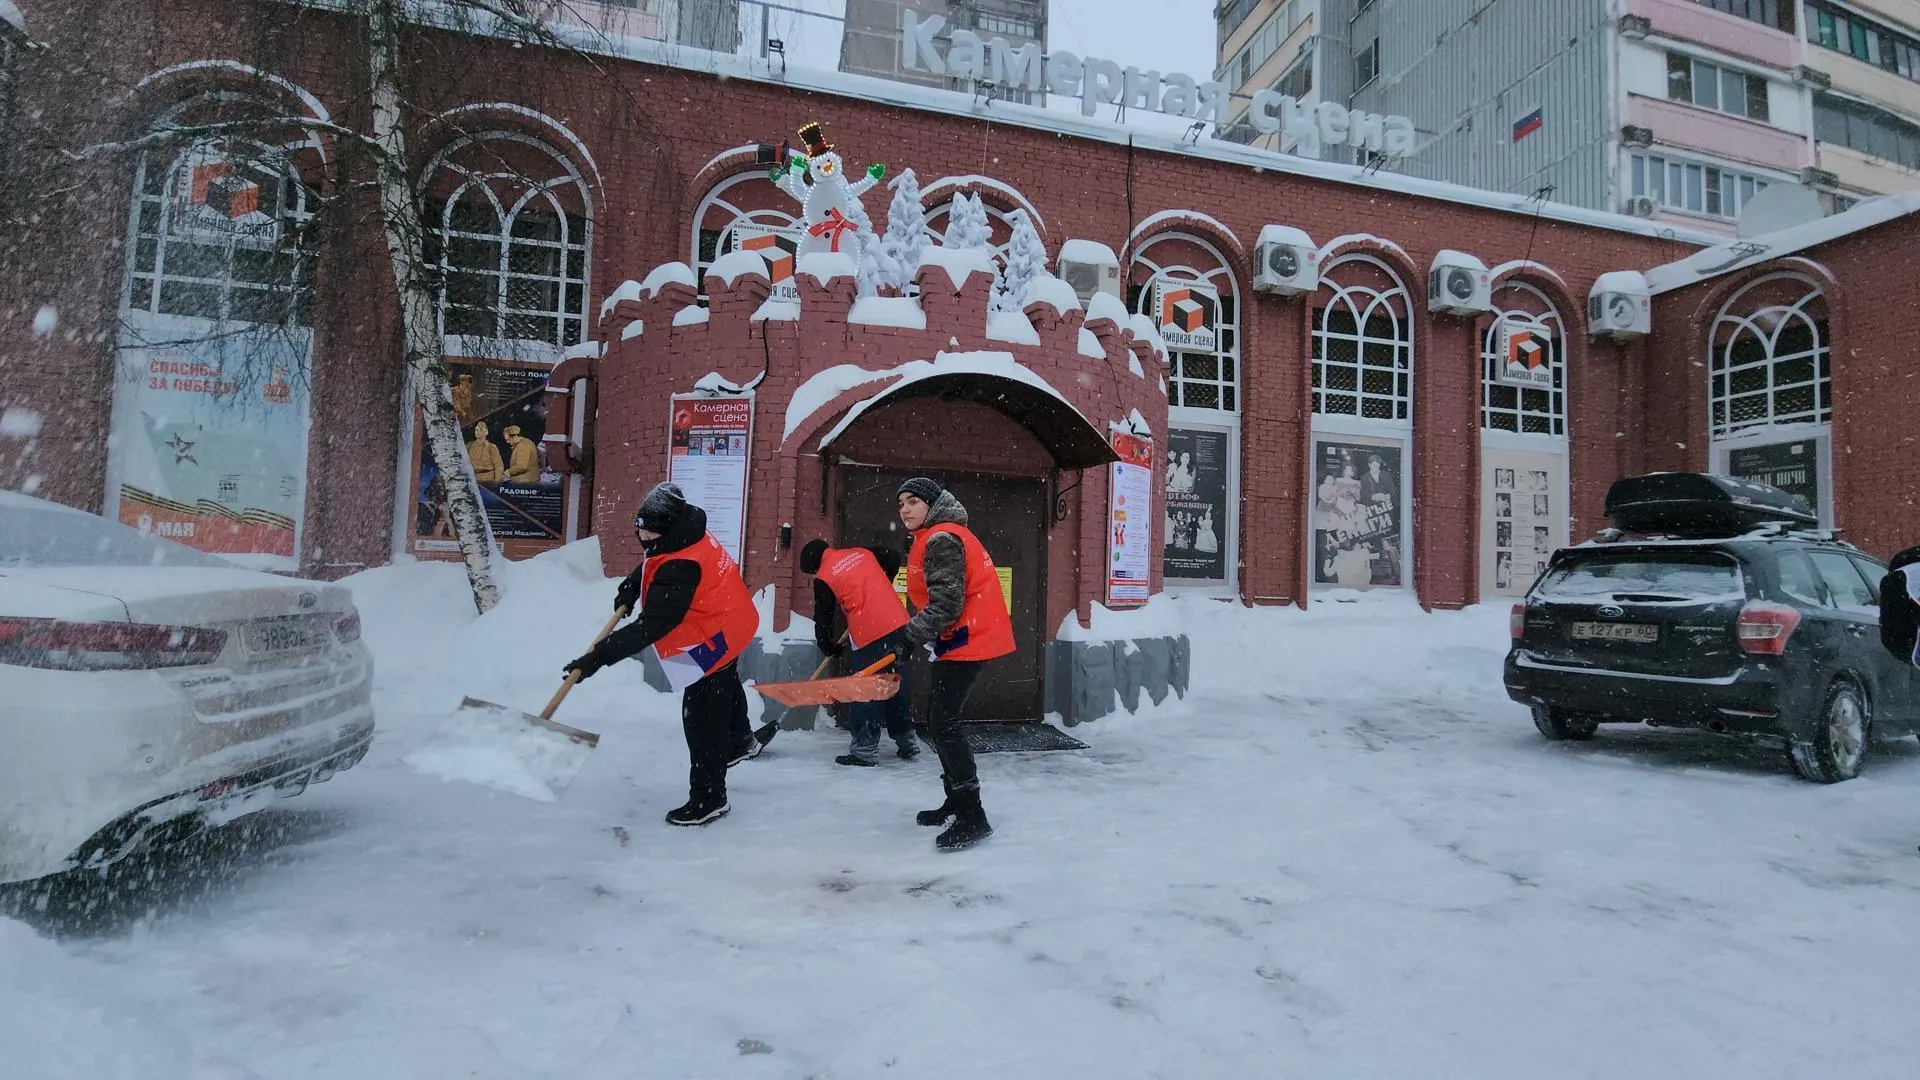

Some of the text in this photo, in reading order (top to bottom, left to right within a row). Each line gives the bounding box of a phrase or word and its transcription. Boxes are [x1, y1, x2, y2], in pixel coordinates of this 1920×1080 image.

[903, 9, 1416, 158] Камерная сцена
[528, 371, 550, 380] поле
[693, 402, 749, 413] Камерная
[713, 413, 748, 423] сцена
[499, 486, 538, 495] Рядовые
[157, 521, 196, 537] МАЯ
